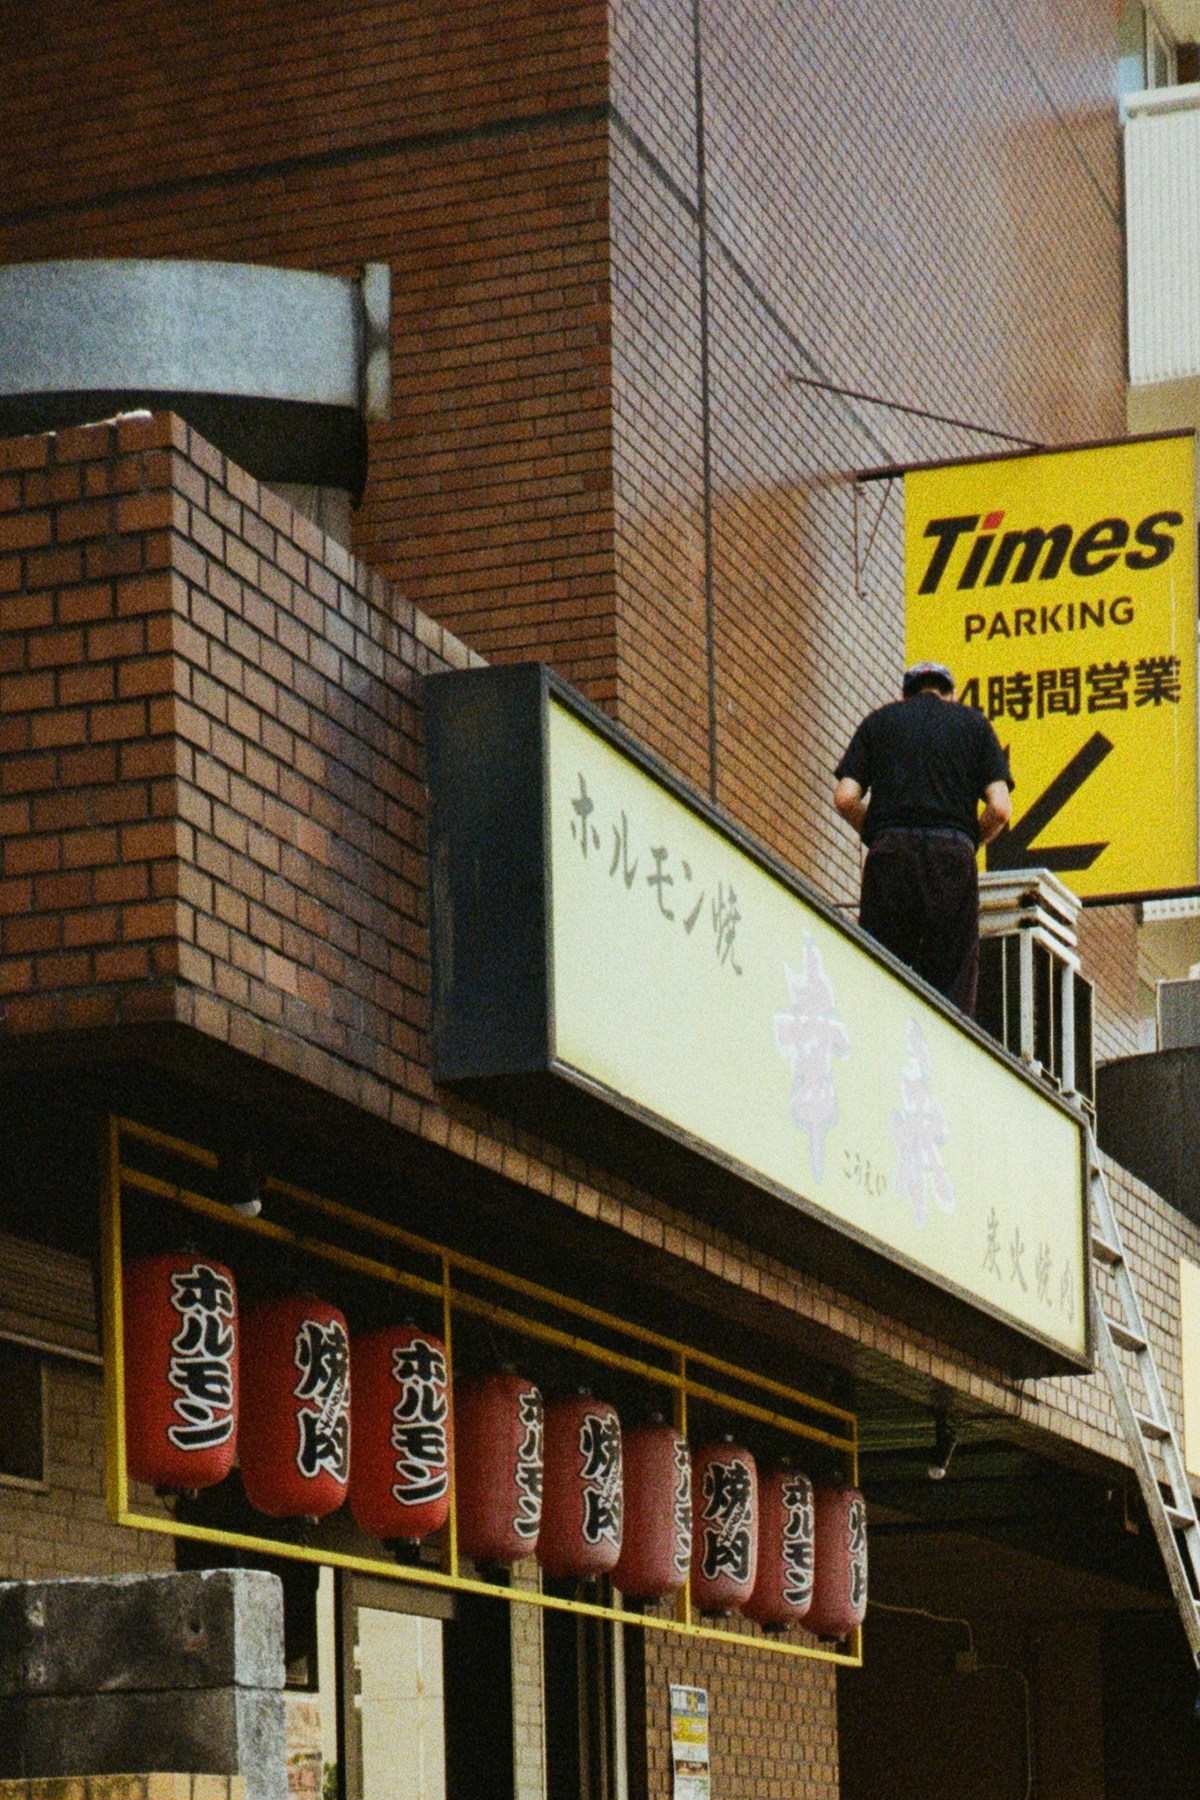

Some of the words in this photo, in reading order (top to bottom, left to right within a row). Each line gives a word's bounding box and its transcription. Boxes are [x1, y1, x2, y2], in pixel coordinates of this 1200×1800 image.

[918, 511, 1184, 595] Times
[965, 597, 1135, 643] PARKING
[958, 656, 1182, 722] 4時間営業
[571, 773, 743, 976] ホルモン焼
[982, 1206, 1077, 1324] 炭火焼肉
[168, 1264, 235, 1450] ホルモン
[293, 1320, 350, 1484] 焼肉
[391, 1339, 449, 1505] ホルモン
[702, 1459, 754, 1584] 焼肉
[781, 1475, 815, 1605] ホルモン
